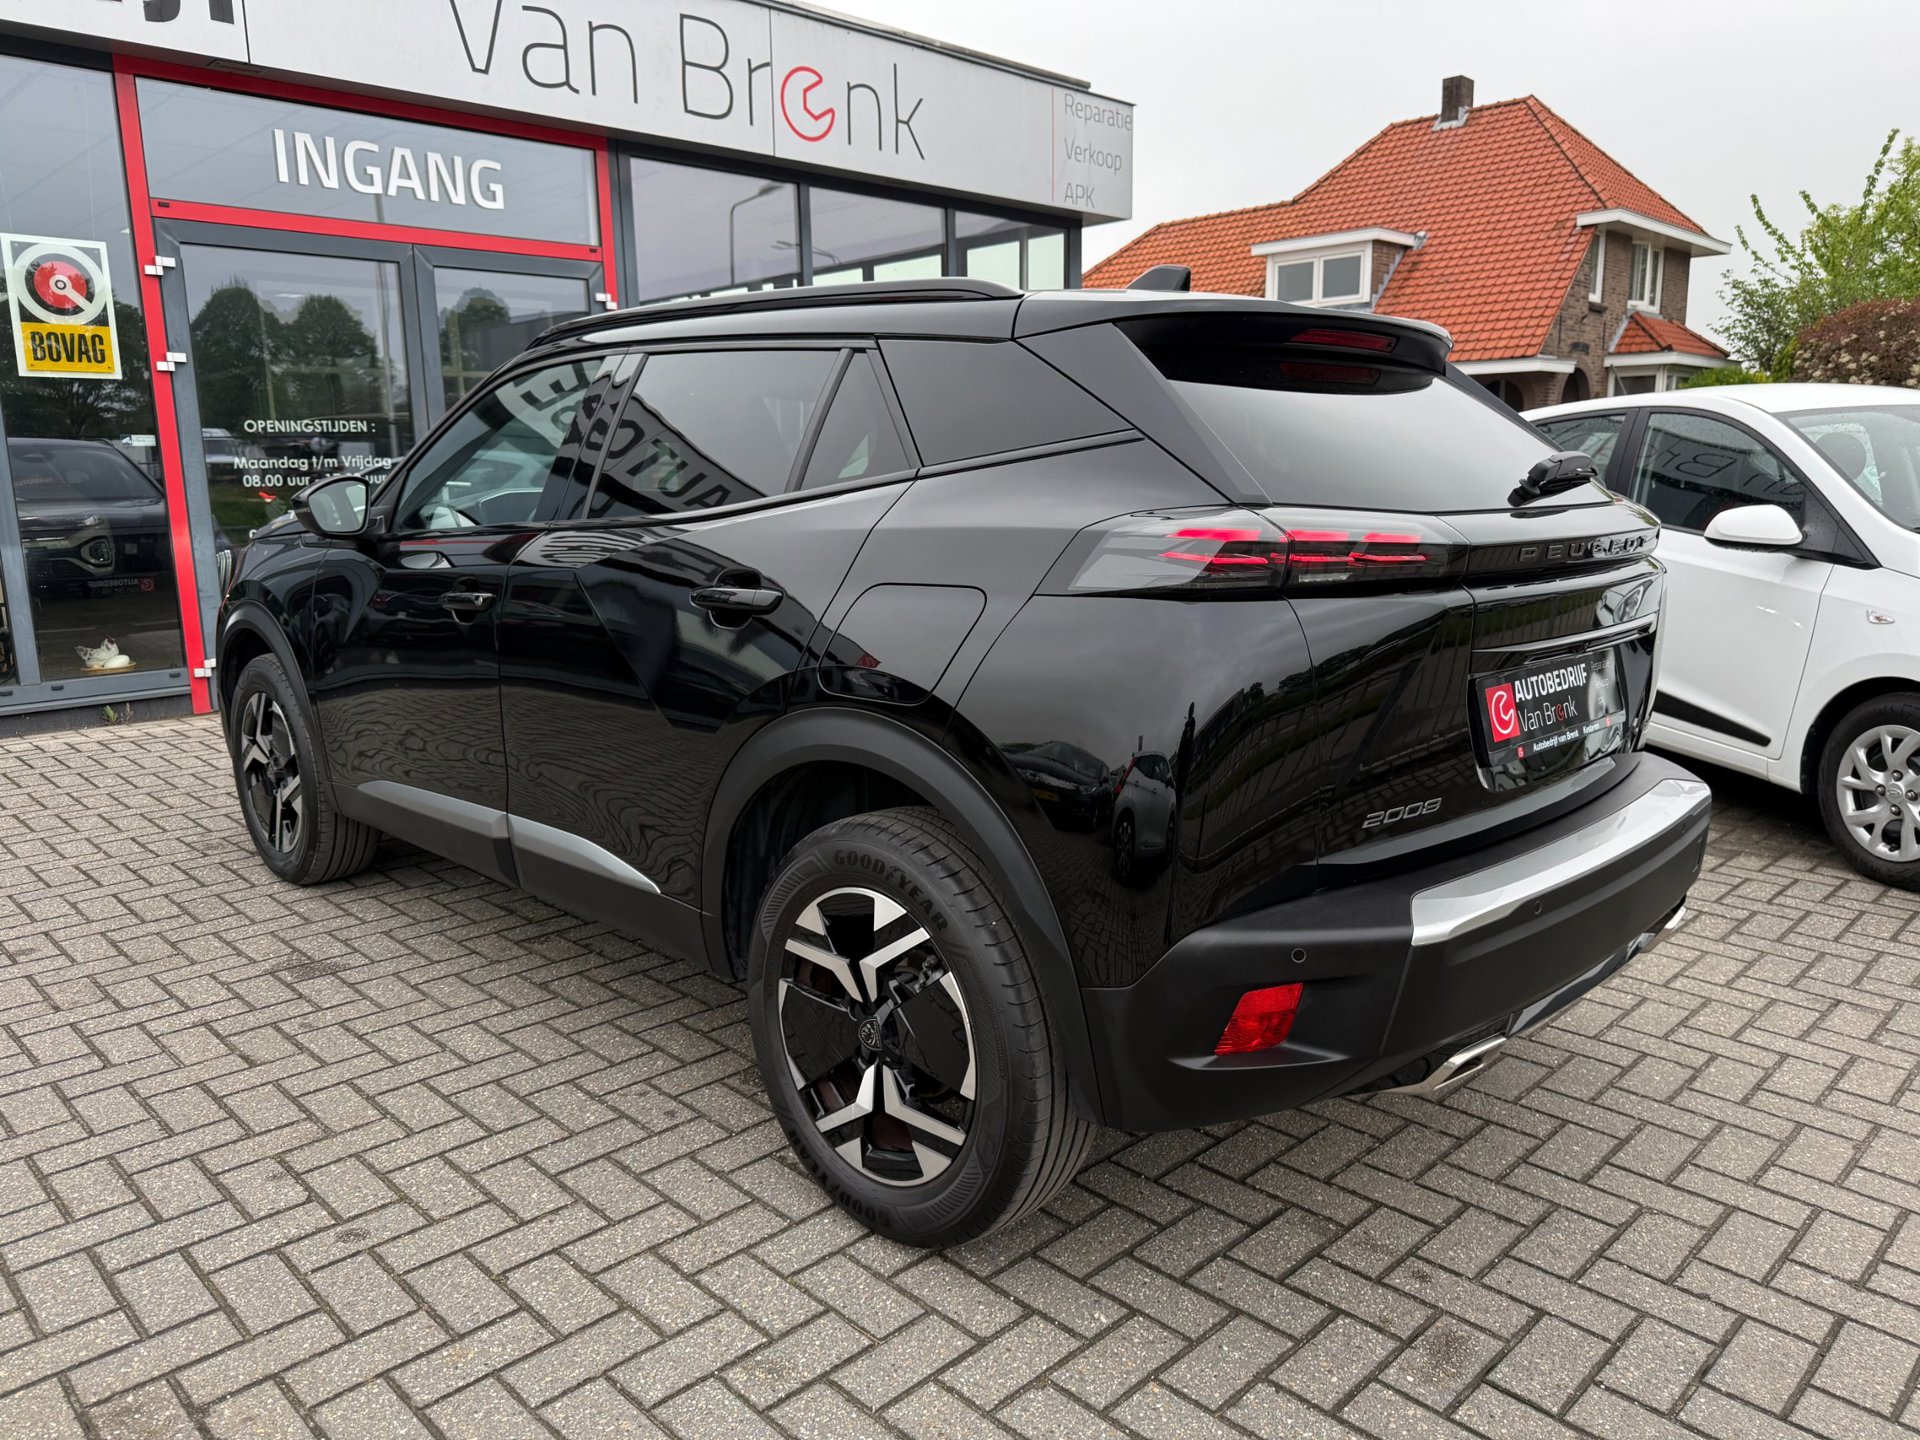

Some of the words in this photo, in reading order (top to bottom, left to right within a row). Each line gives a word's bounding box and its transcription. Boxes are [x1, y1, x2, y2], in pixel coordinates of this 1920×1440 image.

[450, 0, 639, 104] Van
[1064, 93, 1133, 131] Reparatie
[274, 128, 505, 210] INGANG
[1064, 137, 1123, 176] Verkoop
[1064, 182, 1096, 209] APK
[30, 331, 106, 364] BOVAG
[243, 419, 368, 433] OPENINGSTIJDEN
[233, 456, 308, 471] Maandag
[312, 456, 338, 470] t/m
[341, 455, 392, 470] Vrijdag
[243, 474, 283, 487] 08.00
[287, 476, 311, 486] uur
[1518, 535, 1648, 561] PEUGEOT
[1514, 663, 1588, 703] AUTOBEDRIJF
[1517, 708, 1544, 732] Van
[1533, 735, 1558, 752] Autobedrijf
[1361, 797, 1443, 829] 2008
[833, 849, 949, 933] GOODYEAR
